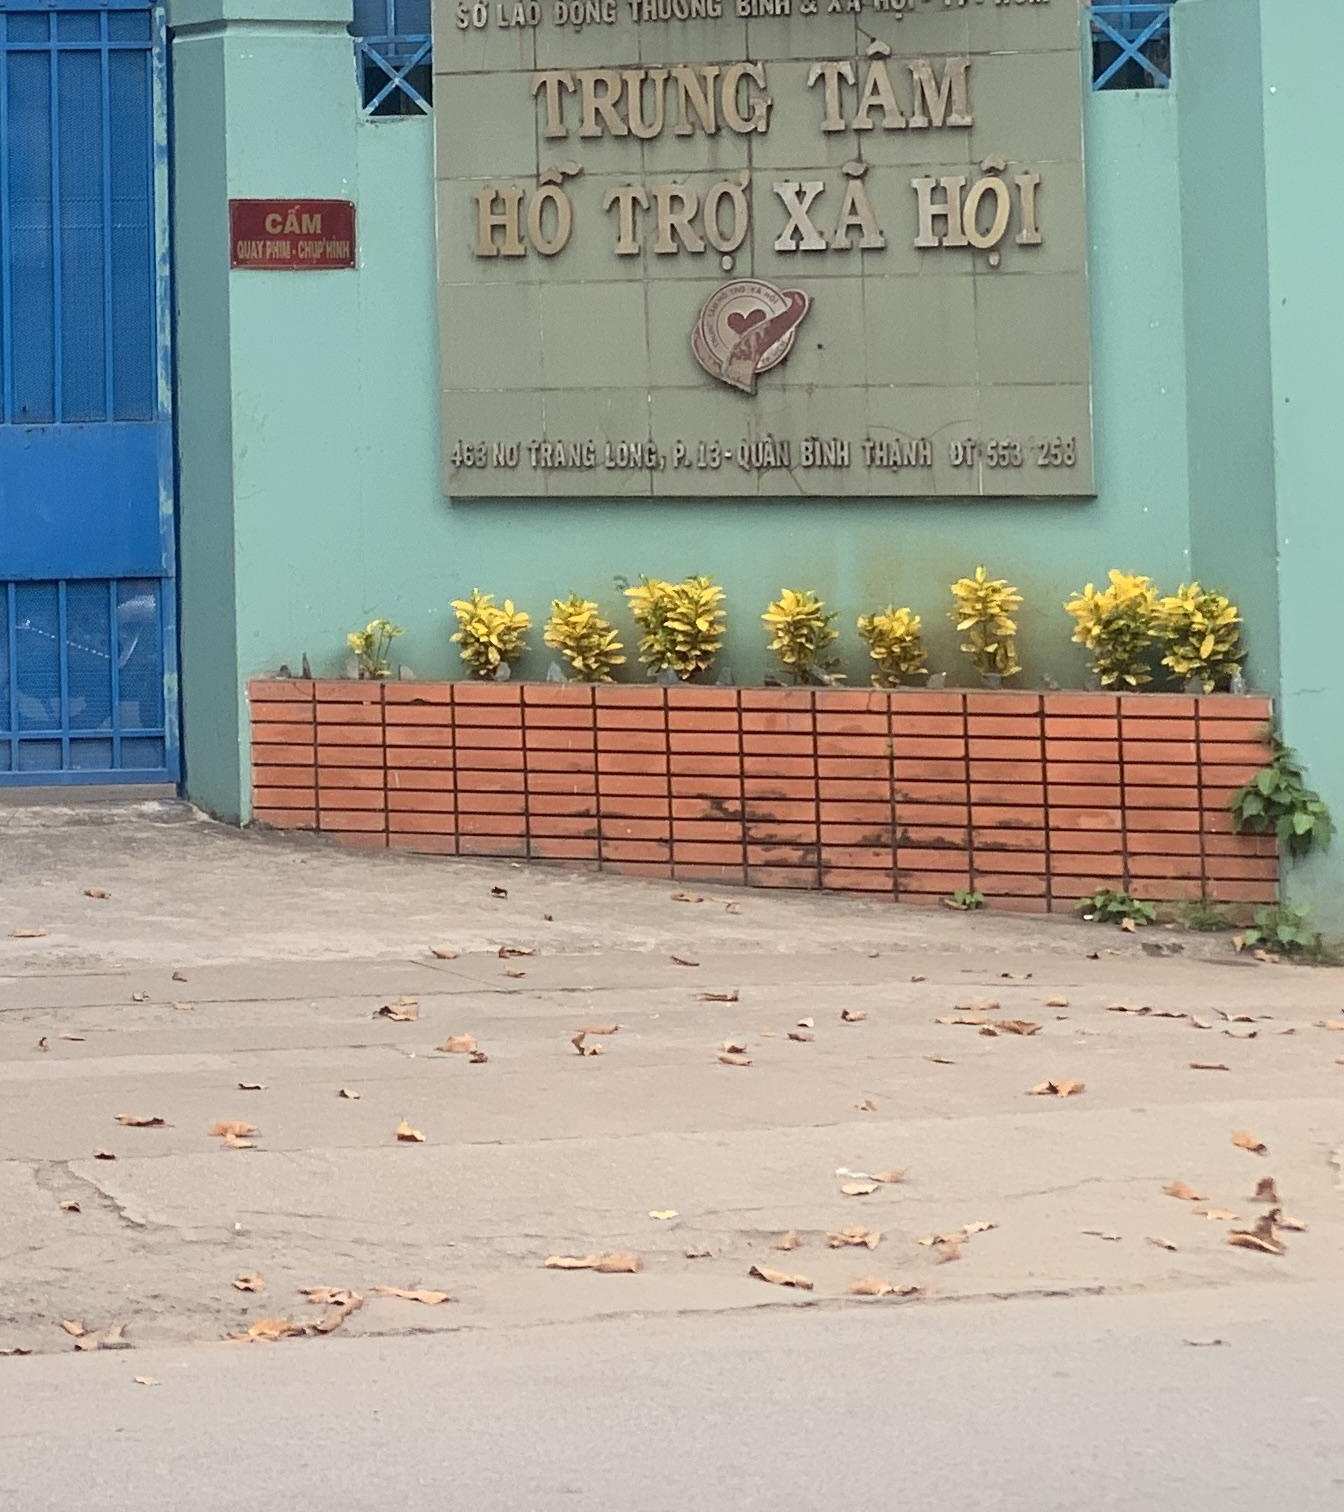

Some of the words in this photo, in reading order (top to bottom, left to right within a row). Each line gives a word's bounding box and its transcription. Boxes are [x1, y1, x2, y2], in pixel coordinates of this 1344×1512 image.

[496, 0, 542, 28] LAO
[532, 61, 773, 139] TRUNG
[807, 39, 974, 132] TÂM
[265, 205, 322, 234] CẤM
[472, 160, 584, 258] HỖ
[603, 170, 752, 271] TRỢ
[773, 161, 886, 251] XÃ
[910, 155, 1044, 267] HỘI
[237, 240, 265, 258] QUAY
[266, 240, 291, 258] PHIM
[528, 441, 596, 469] TRANG
[861, 440, 933, 473] THẠNH
